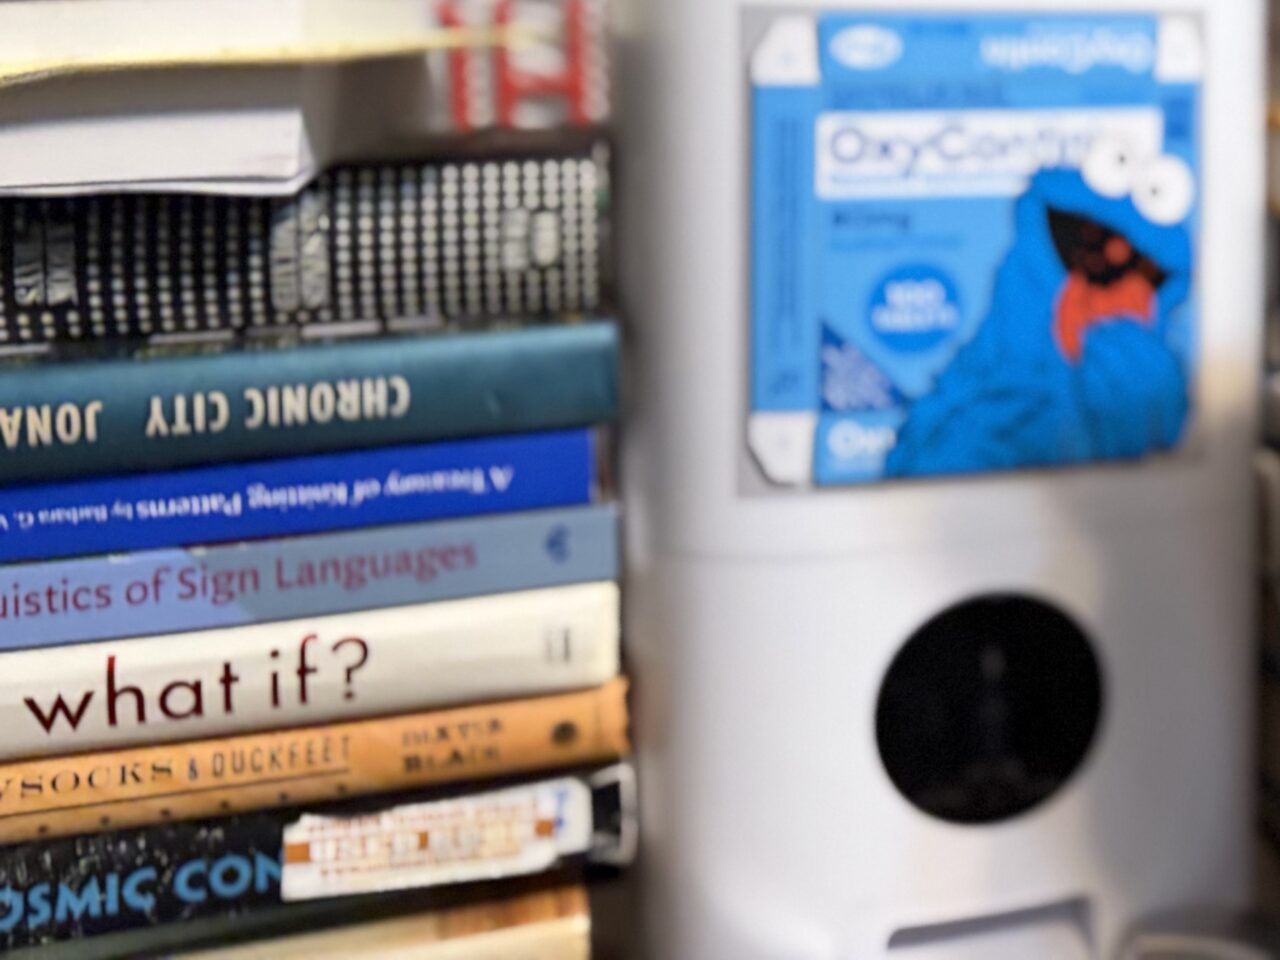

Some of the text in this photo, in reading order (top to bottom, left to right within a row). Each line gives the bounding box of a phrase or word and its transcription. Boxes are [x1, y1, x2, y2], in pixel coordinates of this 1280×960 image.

[0, 375, 411, 448] CHRONIC CITY JONA
[352, 478, 382, 507] of
[383, 468, 486, 496] Treasury
[489, 465, 515, 494] A
[111, 498, 133, 520] by
[136, 492, 242, 520] Patterns
[247, 482, 348, 511] Knitting
[38, 504, 108, 524] Barbara
[124, 565, 172, 606] of
[176, 562, 260, 607] Sign
[275, 542, 478, 591] Languages
[23, 633, 370, 734] what if?
[212, 735, 350, 779] DUCKFEET
[0, 866, 157, 933] OSMIC
